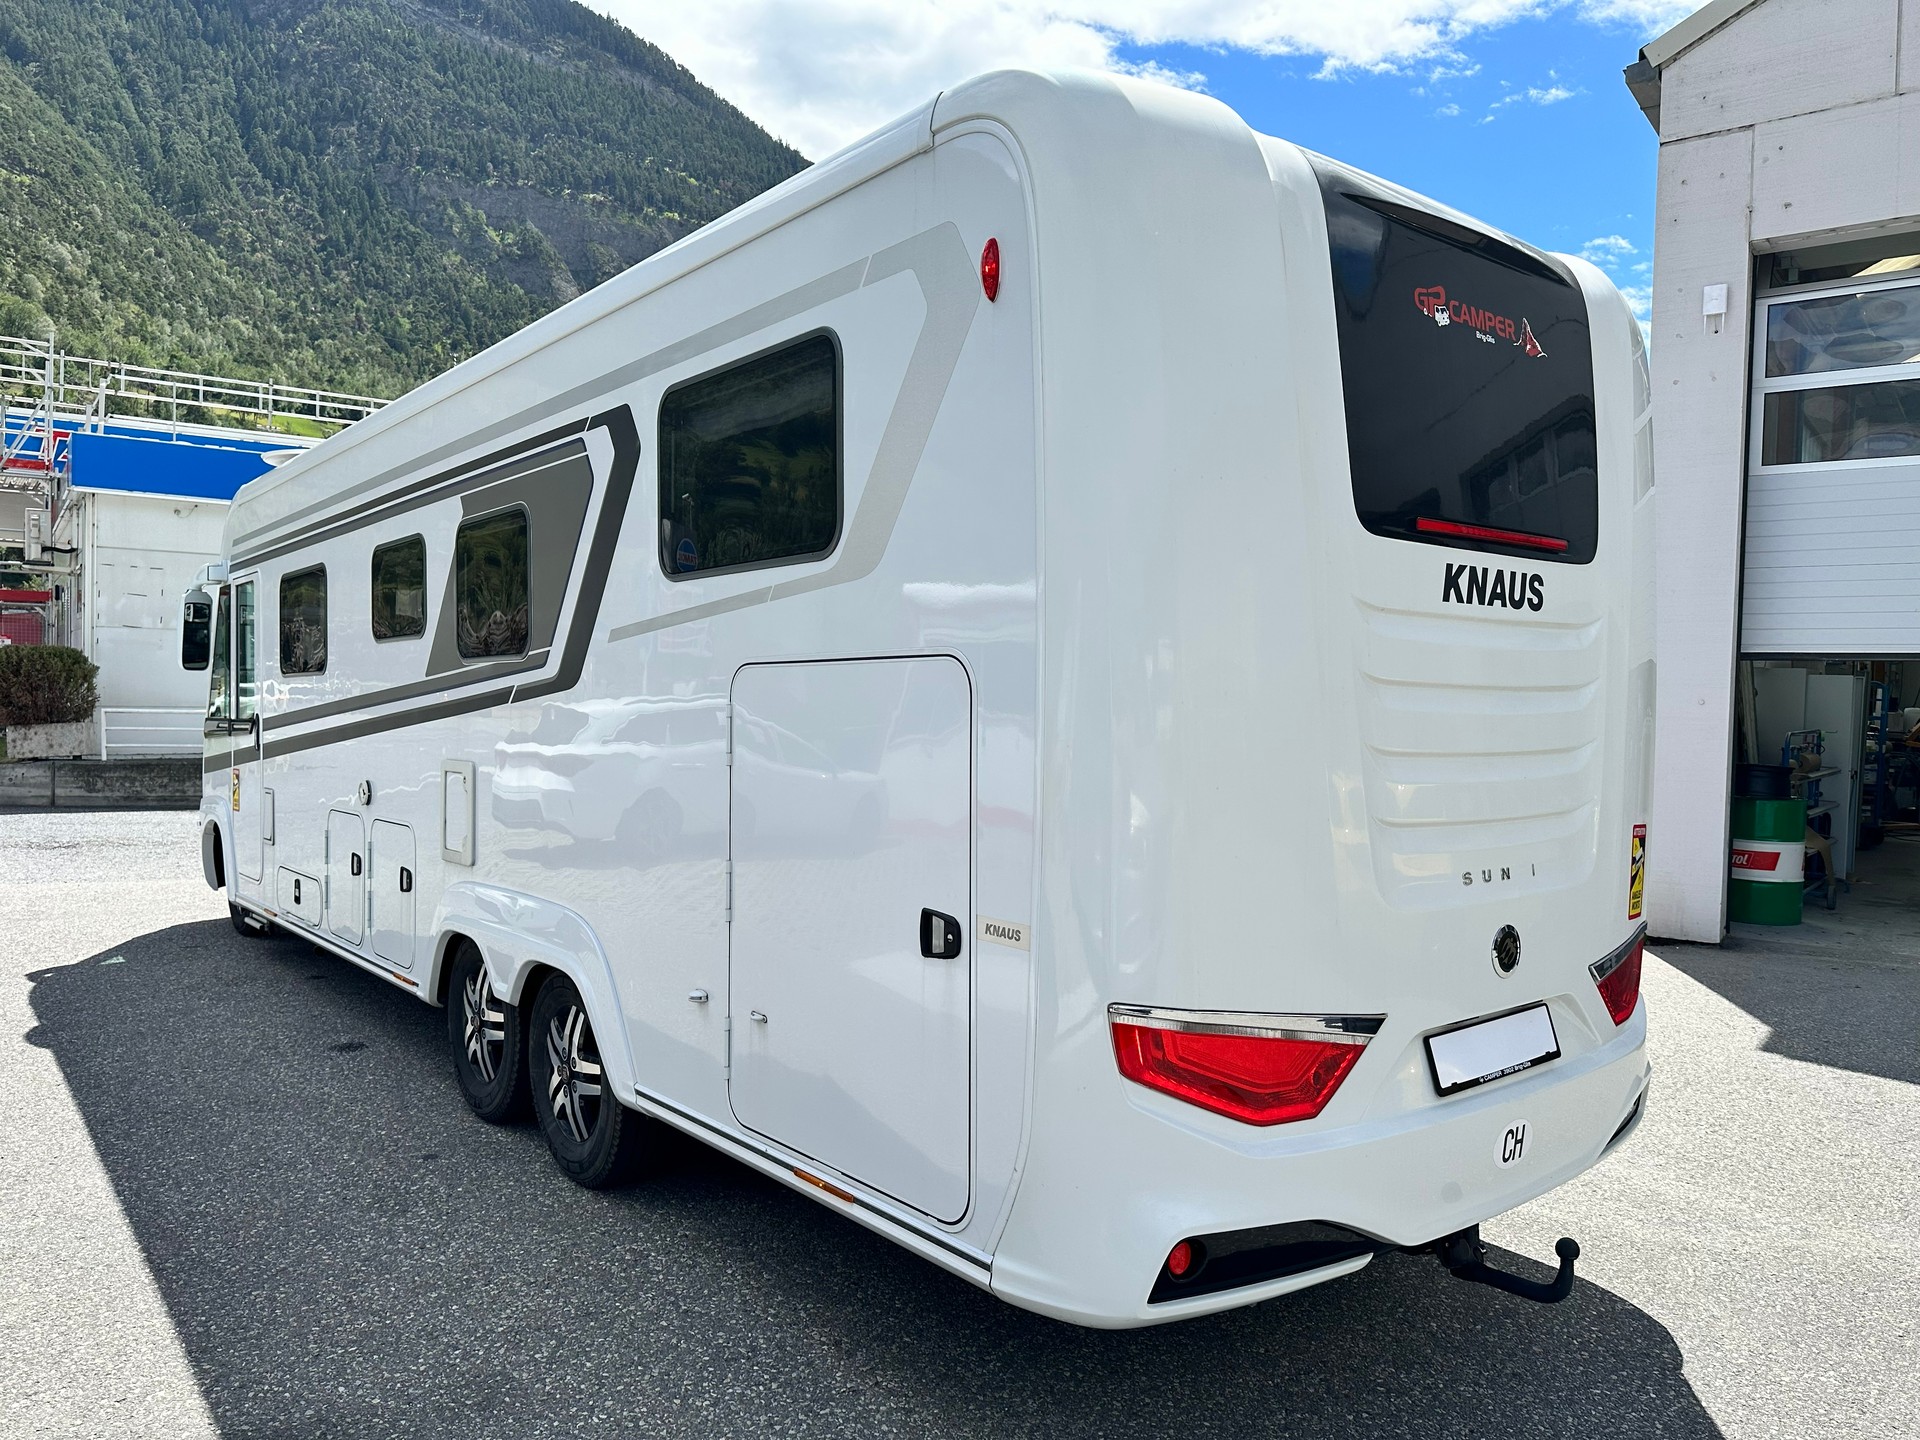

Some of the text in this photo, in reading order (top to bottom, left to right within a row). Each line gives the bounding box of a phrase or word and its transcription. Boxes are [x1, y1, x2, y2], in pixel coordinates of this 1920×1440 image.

[1449, 299, 1517, 341] CAMPER
[1442, 562, 1545, 612] KNAUS
[1732, 854, 1748, 865] rol
[1461, 866, 1511, 887] SUN
[984, 922, 1022, 942] KNAUS
[1502, 1123, 1526, 1163] CH
